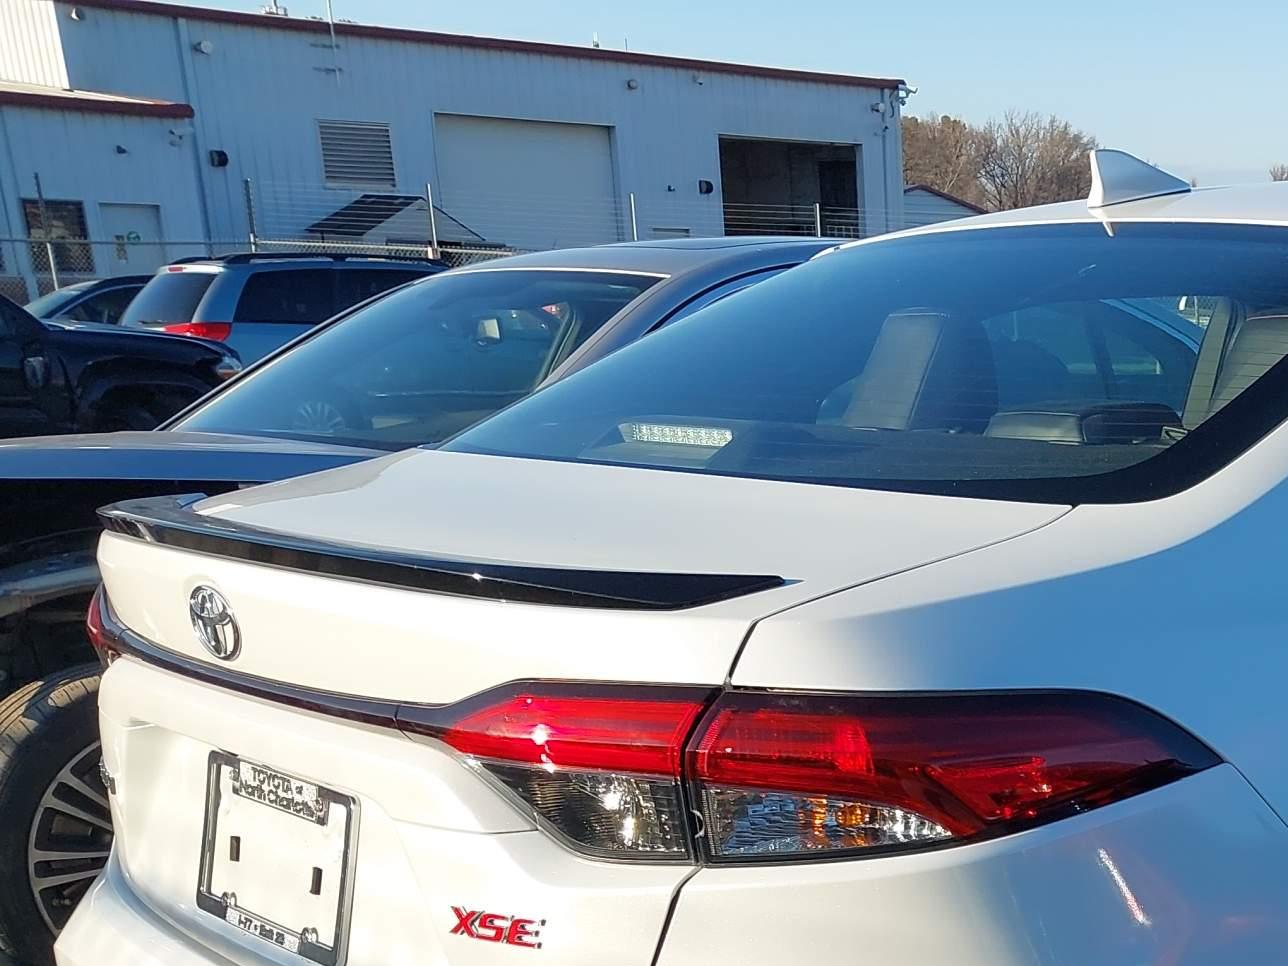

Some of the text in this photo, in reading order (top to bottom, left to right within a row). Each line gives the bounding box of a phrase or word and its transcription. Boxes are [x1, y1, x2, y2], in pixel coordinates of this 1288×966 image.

[239, 779, 266, 802] North
[251, 766, 293, 796] TOYOTA
[448, 905, 546, 949] XSE
